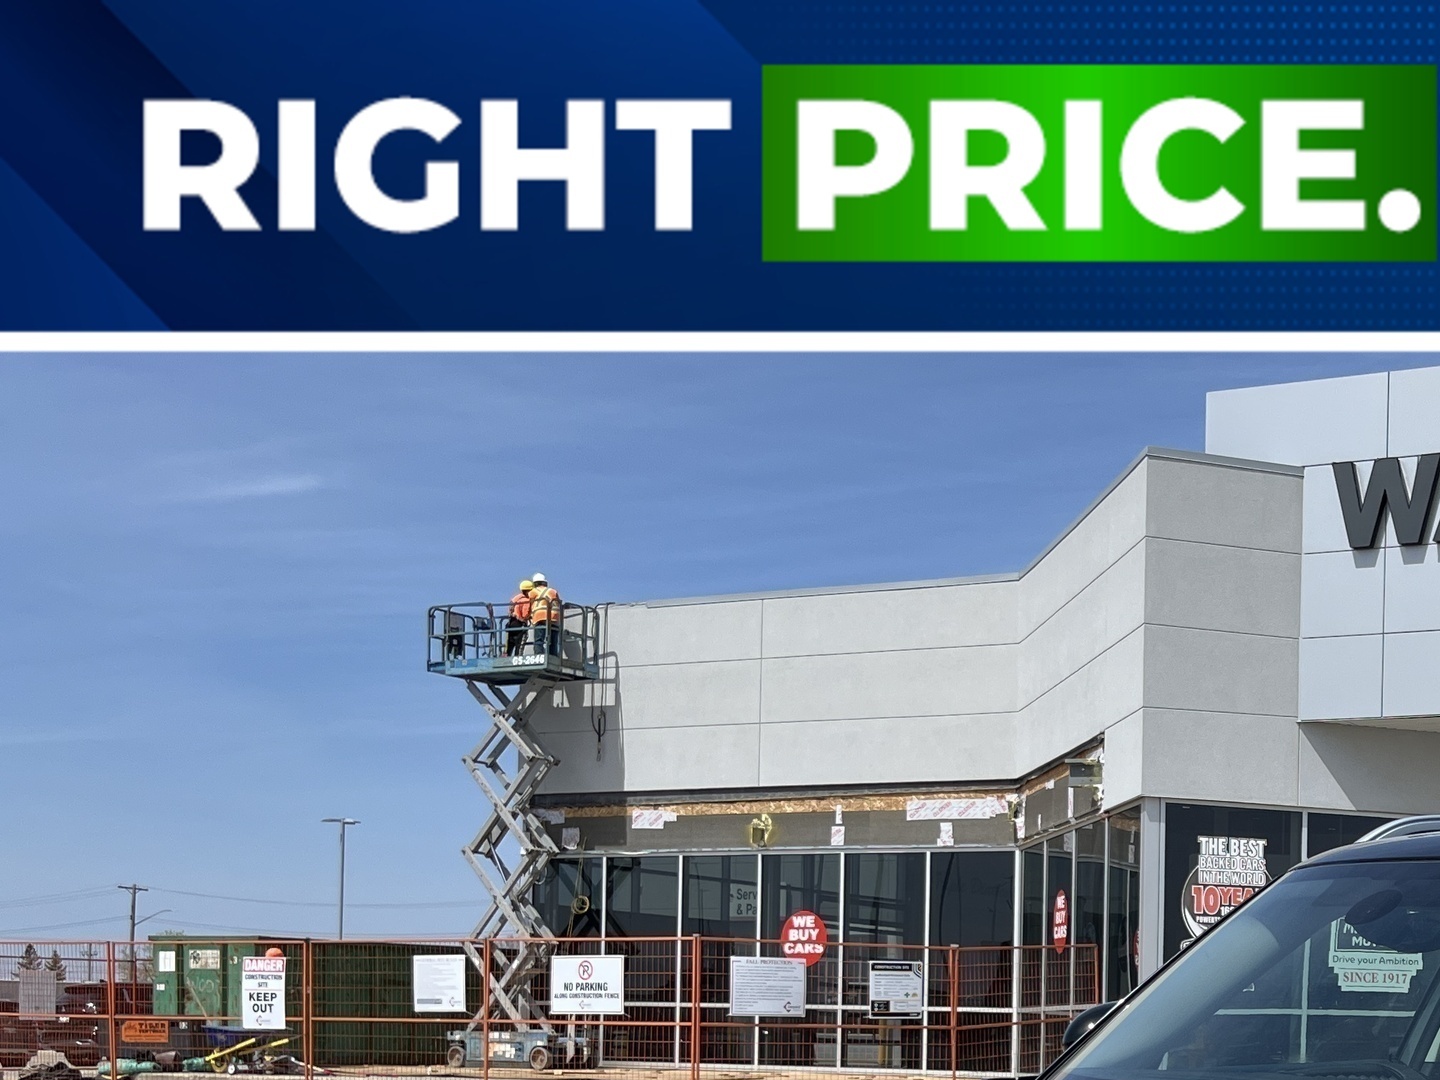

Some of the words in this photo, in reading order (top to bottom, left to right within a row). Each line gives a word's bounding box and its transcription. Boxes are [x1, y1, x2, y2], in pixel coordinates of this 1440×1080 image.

[1198, 837, 1228, 856] THE
[1229, 838, 1267, 858] BEST
[1200, 856, 1237, 870] BACKED
[1239, 858, 1266, 871] CARS
[1200, 870, 1211, 883] IN
[1211, 871, 1229, 884] THE
[1231, 872, 1265, 885] WORLD
[1192, 885, 1220, 915] 10
[1219, 886, 1259, 906] YEA
[792, 915, 816, 928] WE
[1055, 909, 1067, 925] BUY
[788, 928, 820, 942] BUY
[1053, 924, 1068, 940] CARS
[784, 942, 824, 955] CARS
[244, 959, 284, 972] DANGER
[1332, 954, 1356, 963] Drive
[1357, 956, 1377, 965] your
[1379, 956, 1419, 966] Ambition
[1343, 971, 1379, 984] SINCE
[1382, 973, 1408, 985] 1917
[563, 982, 573, 991] NO
[575, 982, 608, 991] PARKING
[248, 992, 277, 1002] KEEP
[252, 1003, 274, 1013] OUT
